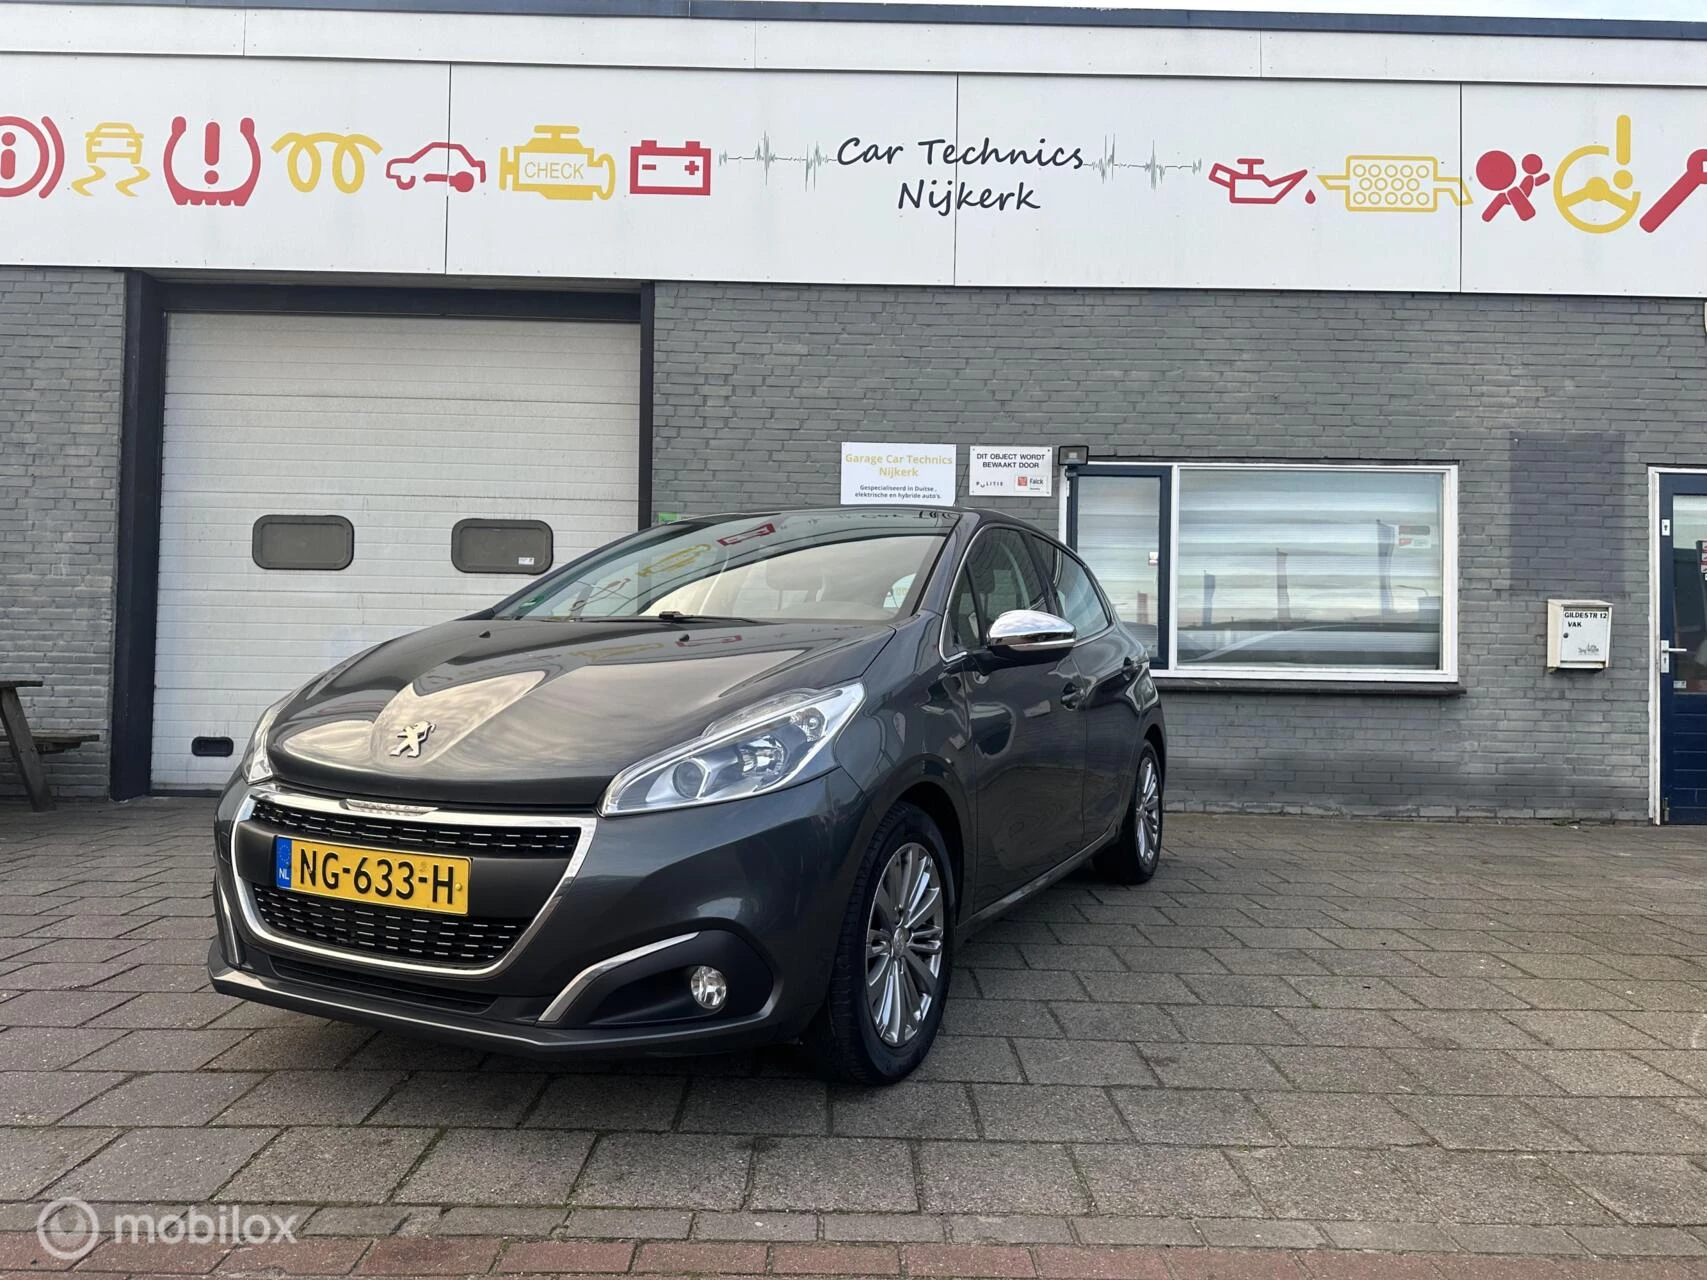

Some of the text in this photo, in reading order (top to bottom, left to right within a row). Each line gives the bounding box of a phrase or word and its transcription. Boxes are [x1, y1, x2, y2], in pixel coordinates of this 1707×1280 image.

[837, 137, 1083, 169] Car Technics
[525, 162, 584, 179] CHECK
[898, 179, 1041, 216] Nijkerk
[845, 454, 953, 465] Garage Car Technics
[879, 467, 919, 478] Nijkerk
[278, 869, 290, 881] NL
[299, 848, 455, 905] NG-633-H
